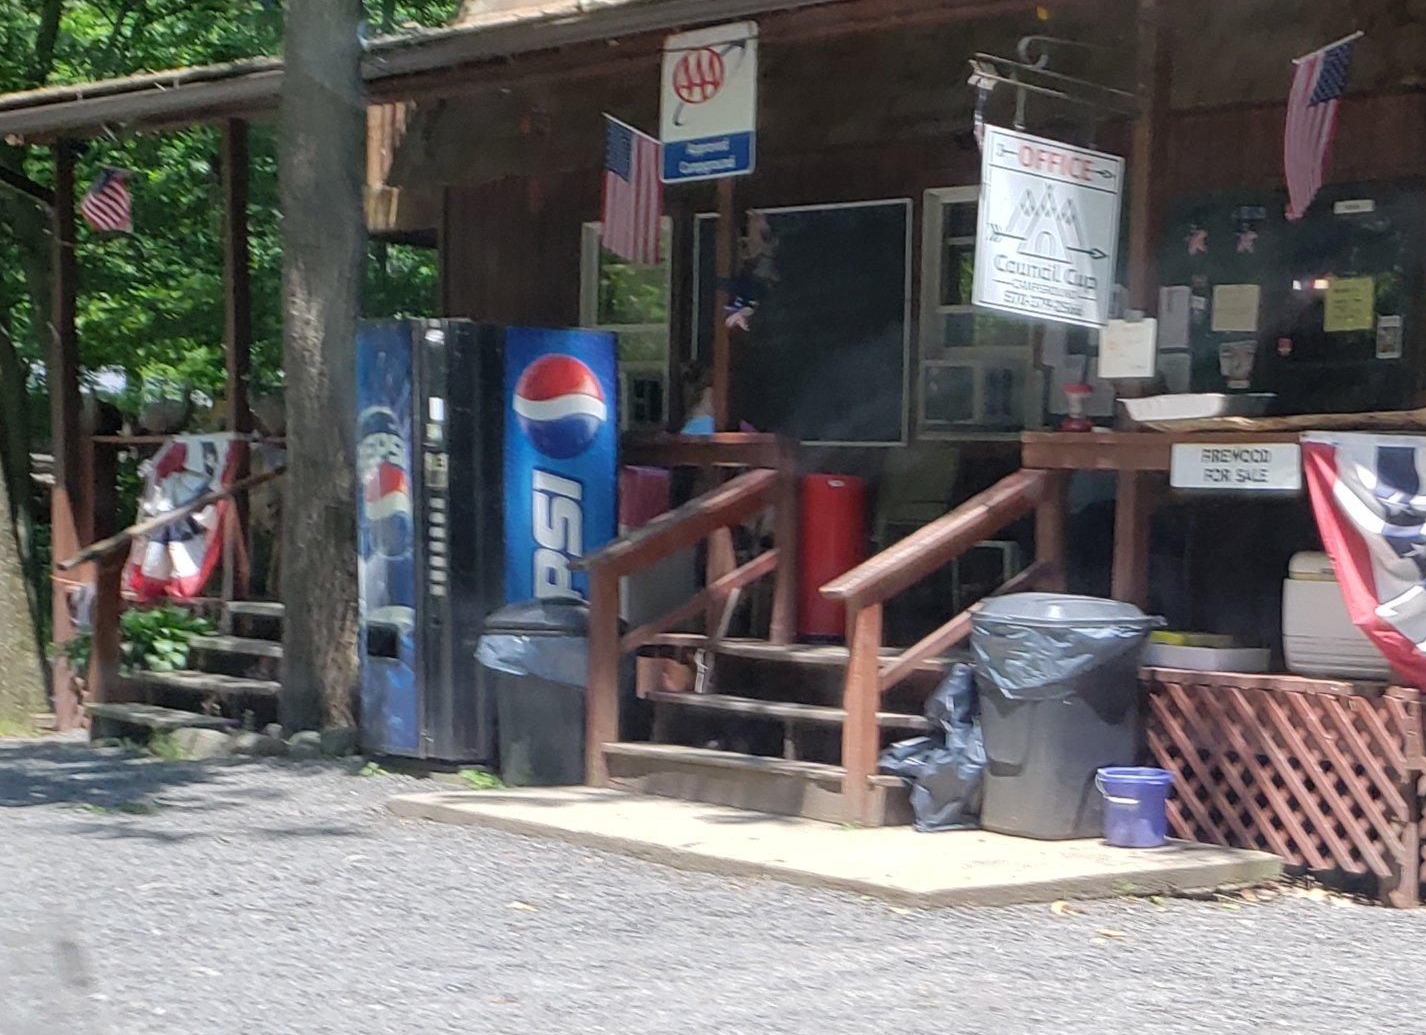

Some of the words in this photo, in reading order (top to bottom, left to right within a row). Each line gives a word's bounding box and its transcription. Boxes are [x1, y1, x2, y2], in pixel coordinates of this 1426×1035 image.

[1018, 145, 1094, 182] OFFICE
[993, 253, 1061, 283] Council
[1063, 268, 1098, 294] Cup
[1203, 468, 1232, 482] FOR
[1235, 468, 1269, 482] SALE
[532, 468, 583, 602] PSI
